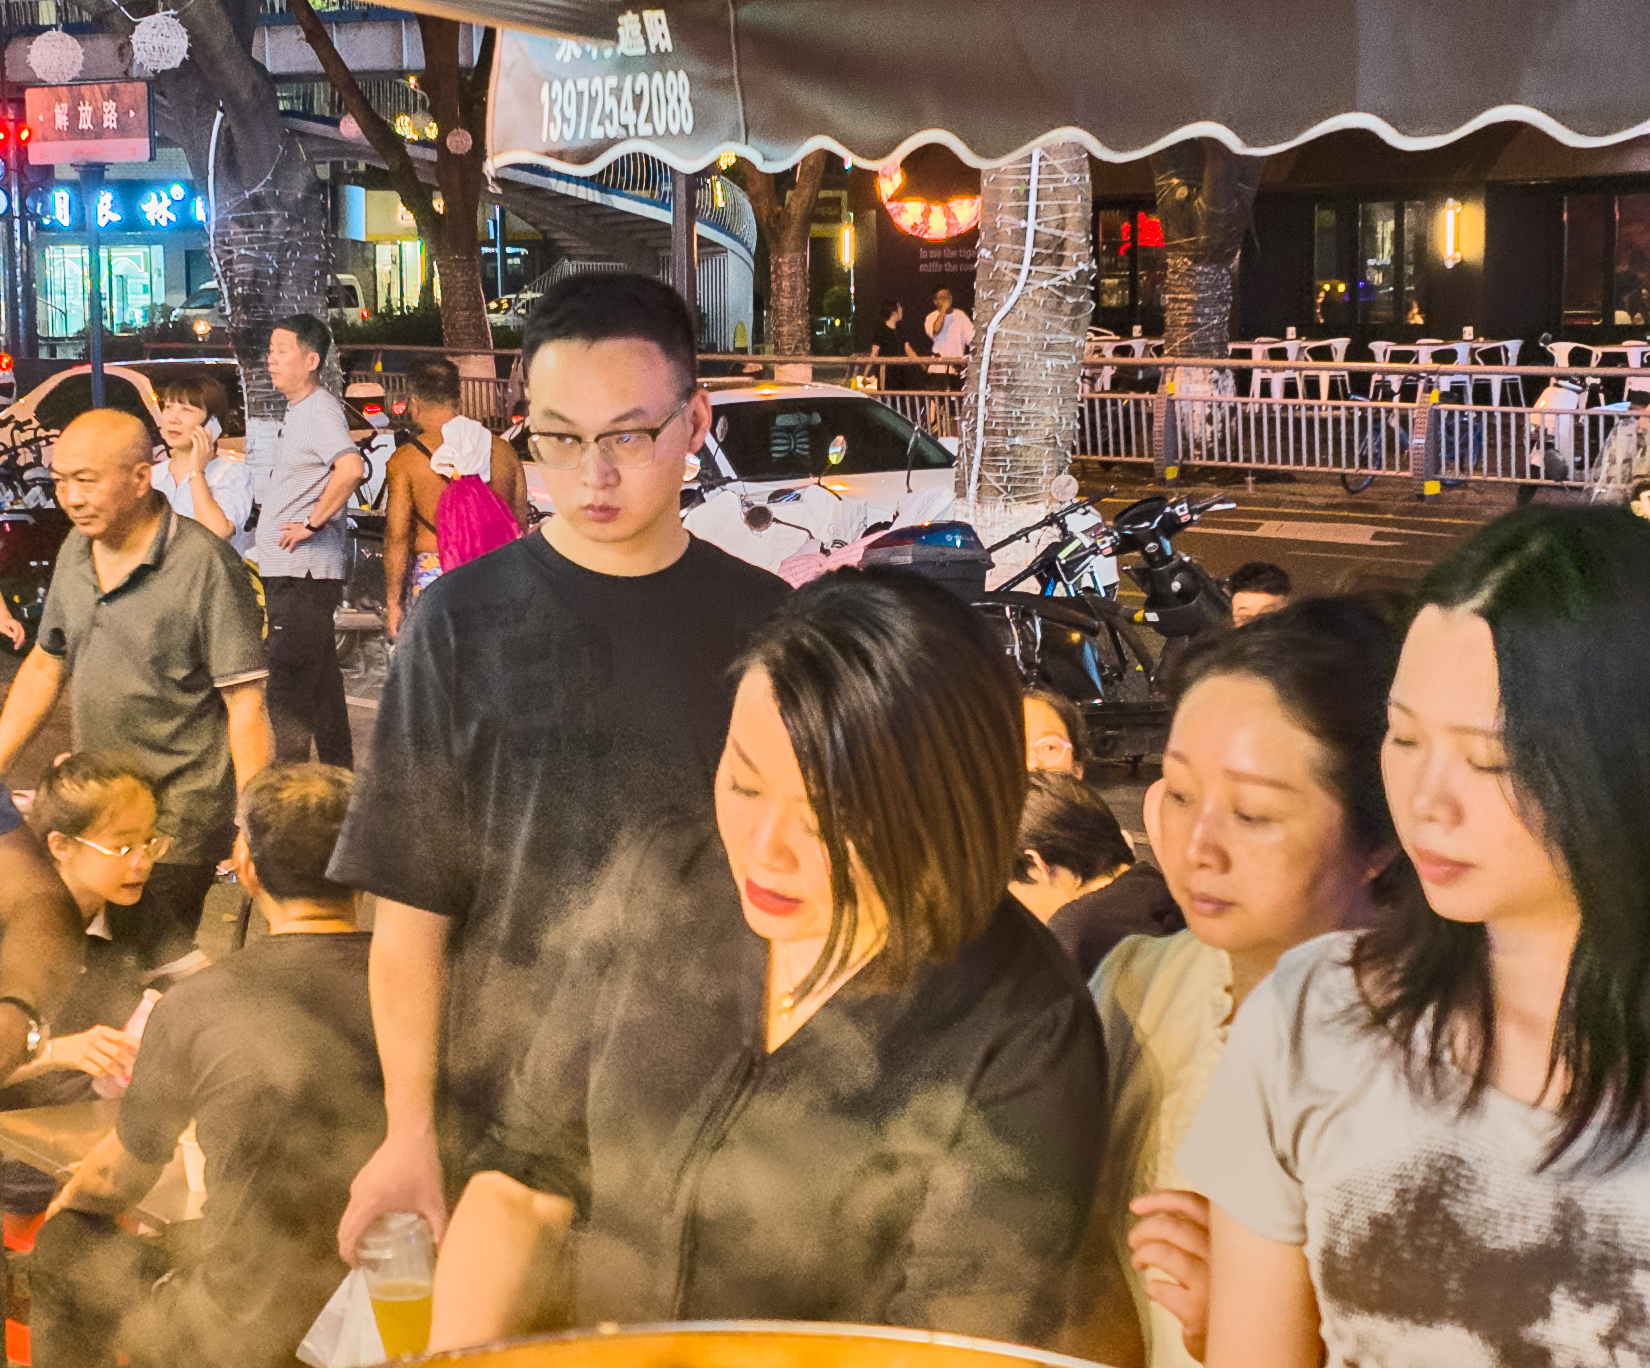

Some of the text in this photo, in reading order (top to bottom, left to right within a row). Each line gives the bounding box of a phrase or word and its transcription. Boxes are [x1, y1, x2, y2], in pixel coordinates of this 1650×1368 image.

[54, 99, 118, 132] 解放路
[540, 68, 695, 143] 13972542088
